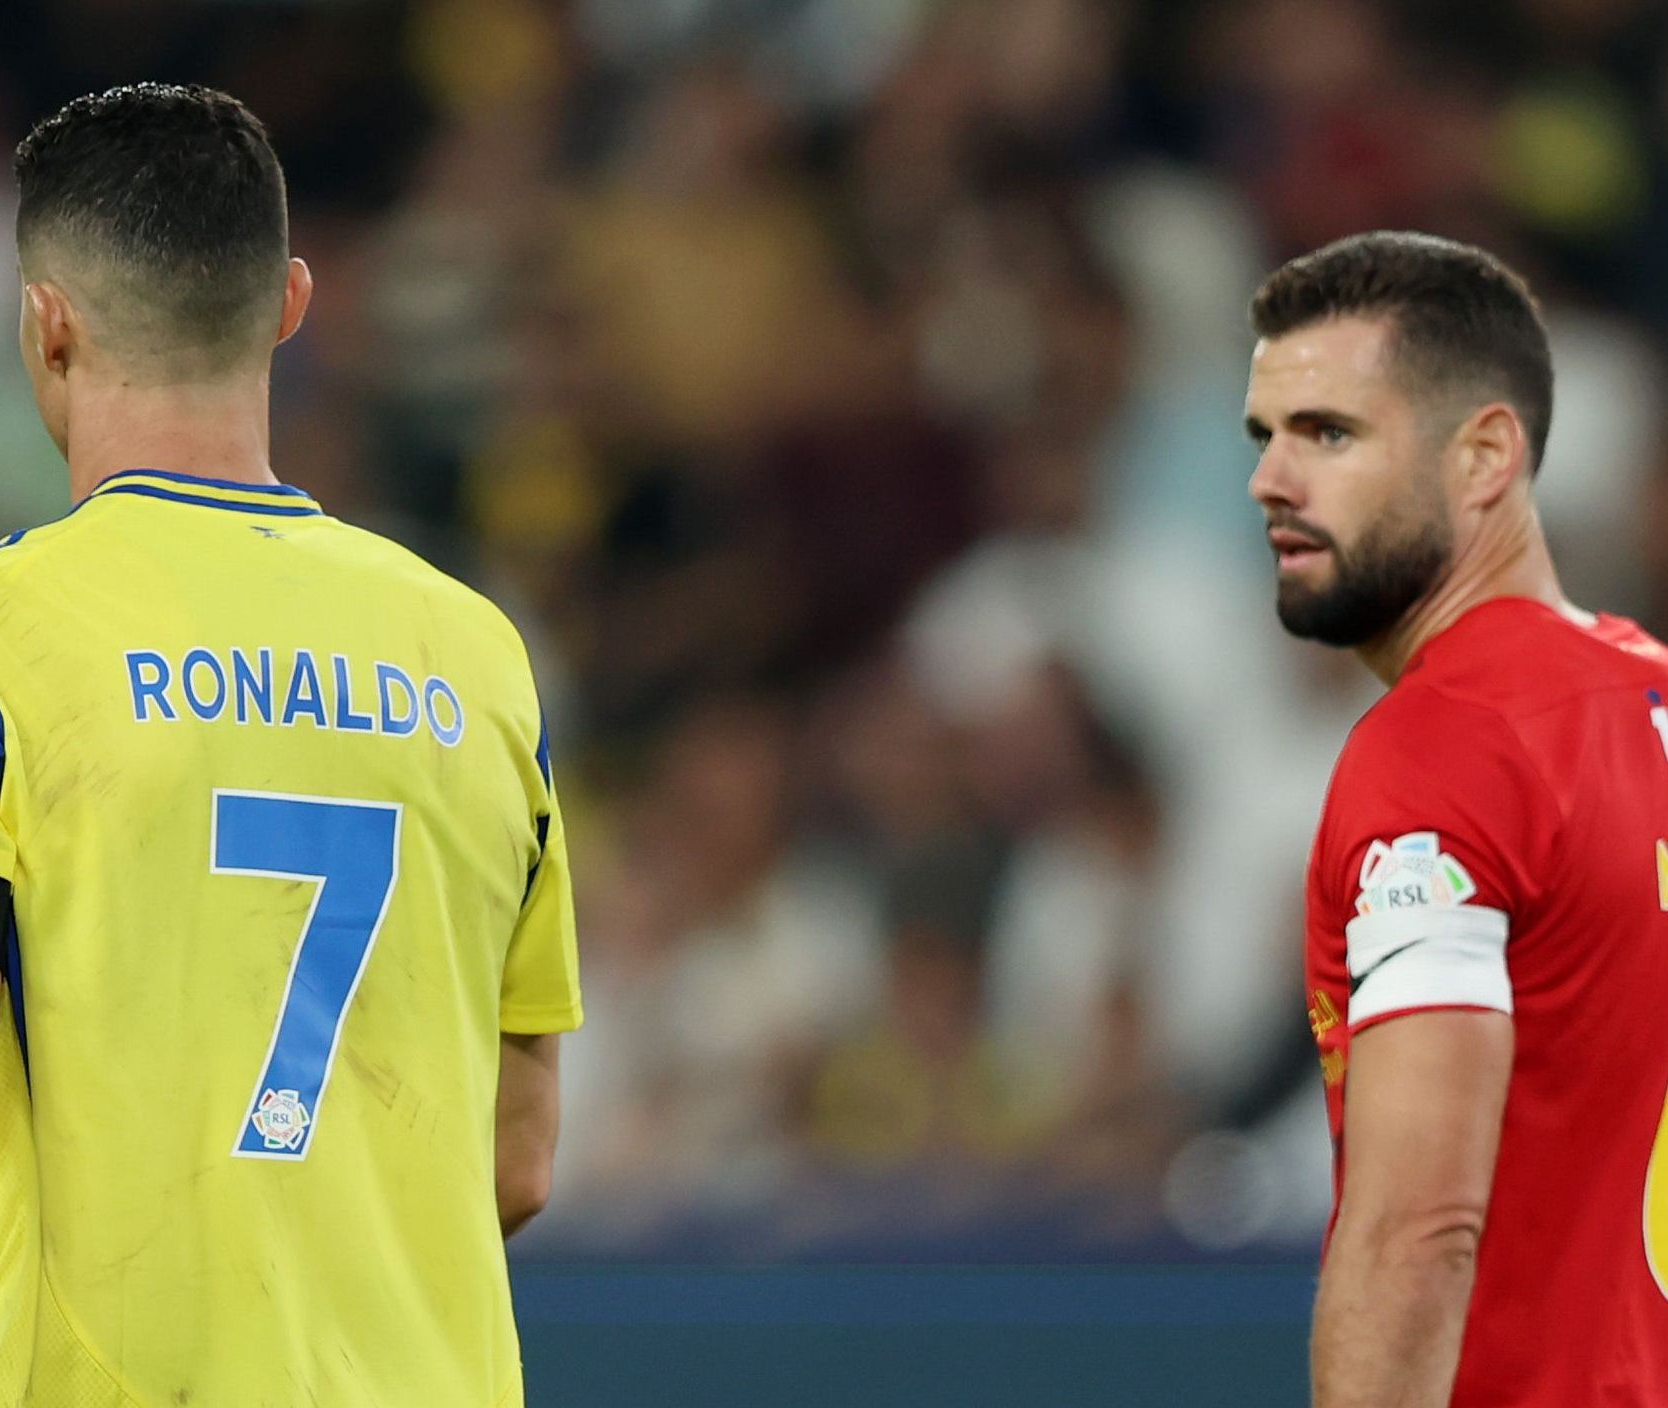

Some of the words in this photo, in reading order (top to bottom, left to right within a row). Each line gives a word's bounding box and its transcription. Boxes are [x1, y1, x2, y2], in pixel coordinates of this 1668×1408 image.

[124, 645, 465, 747] RONALDO
[1388, 885, 1428, 907] RSL
[210, 787, 404, 1162] 7
[273, 1113, 290, 1123] RSL
